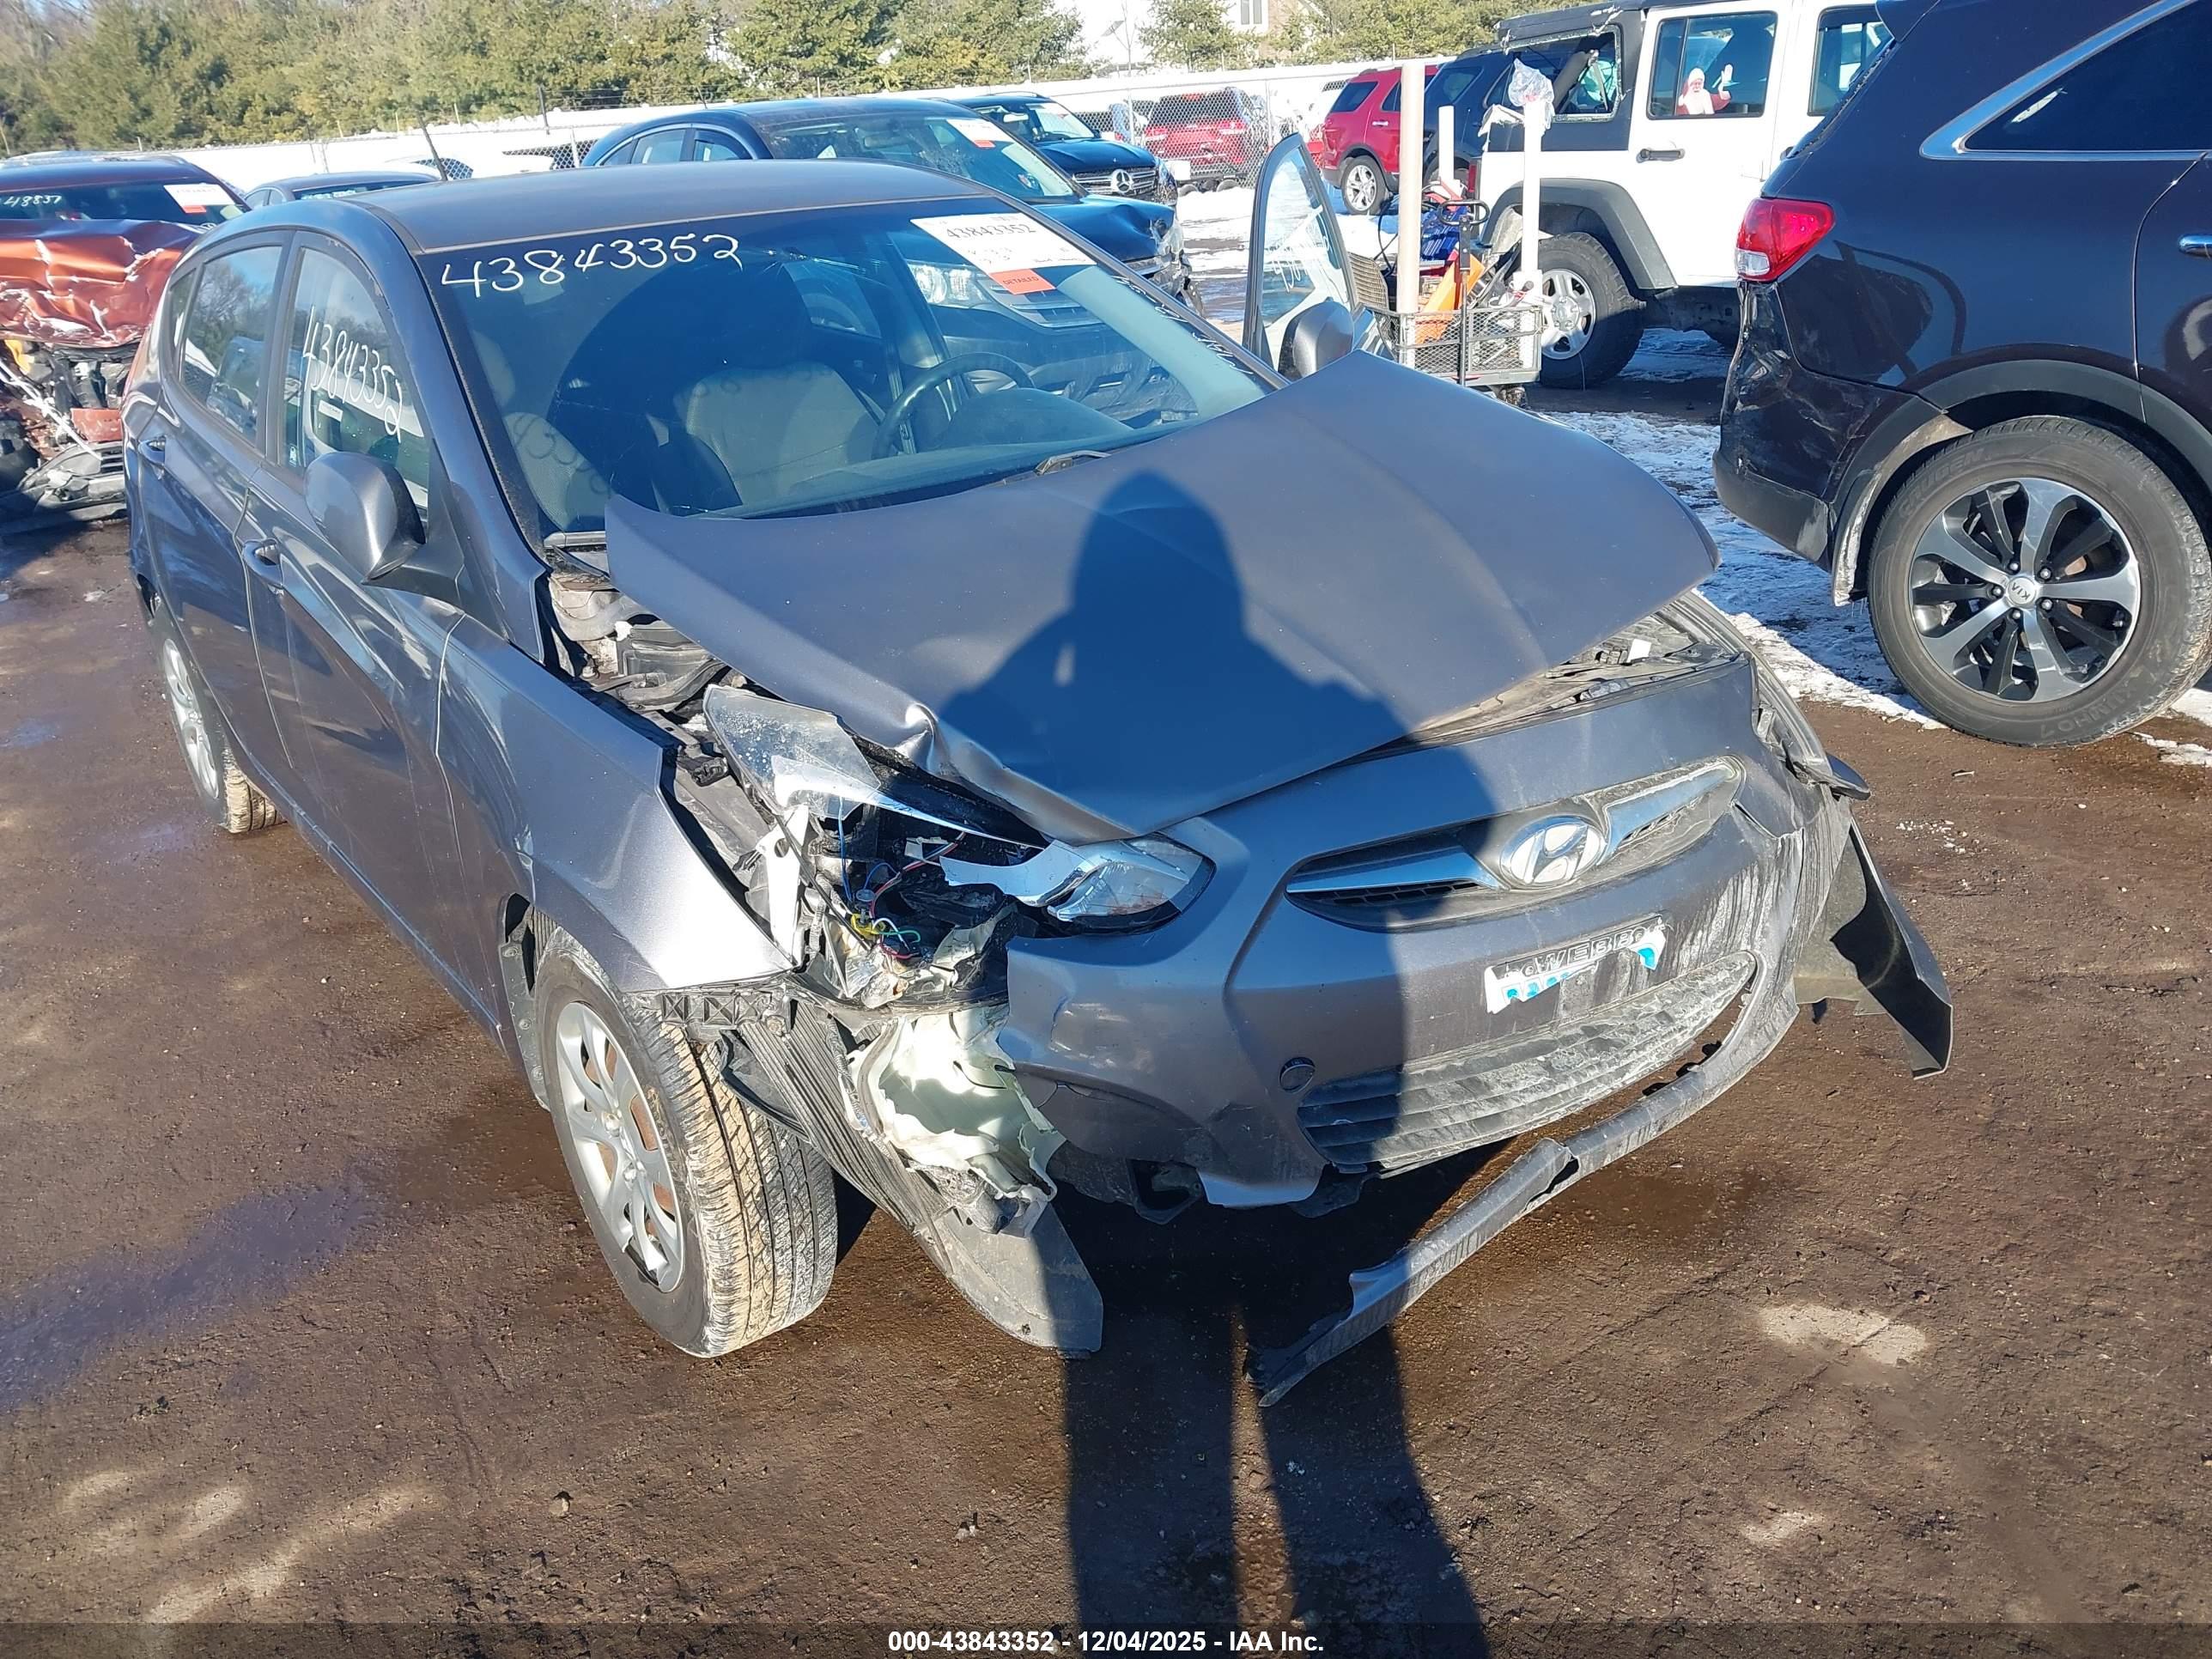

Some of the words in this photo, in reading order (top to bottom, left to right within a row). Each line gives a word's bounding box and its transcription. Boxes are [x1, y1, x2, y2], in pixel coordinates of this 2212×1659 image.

[0, 194, 62, 208] 48837
[945, 223, 1036, 239] 43843352
[441, 233, 744, 298] 43843352
[1002, 276, 1040, 286] DETAILED
[302, 305, 403, 444] 43843352
[2011, 582, 2031, 601] KIA
